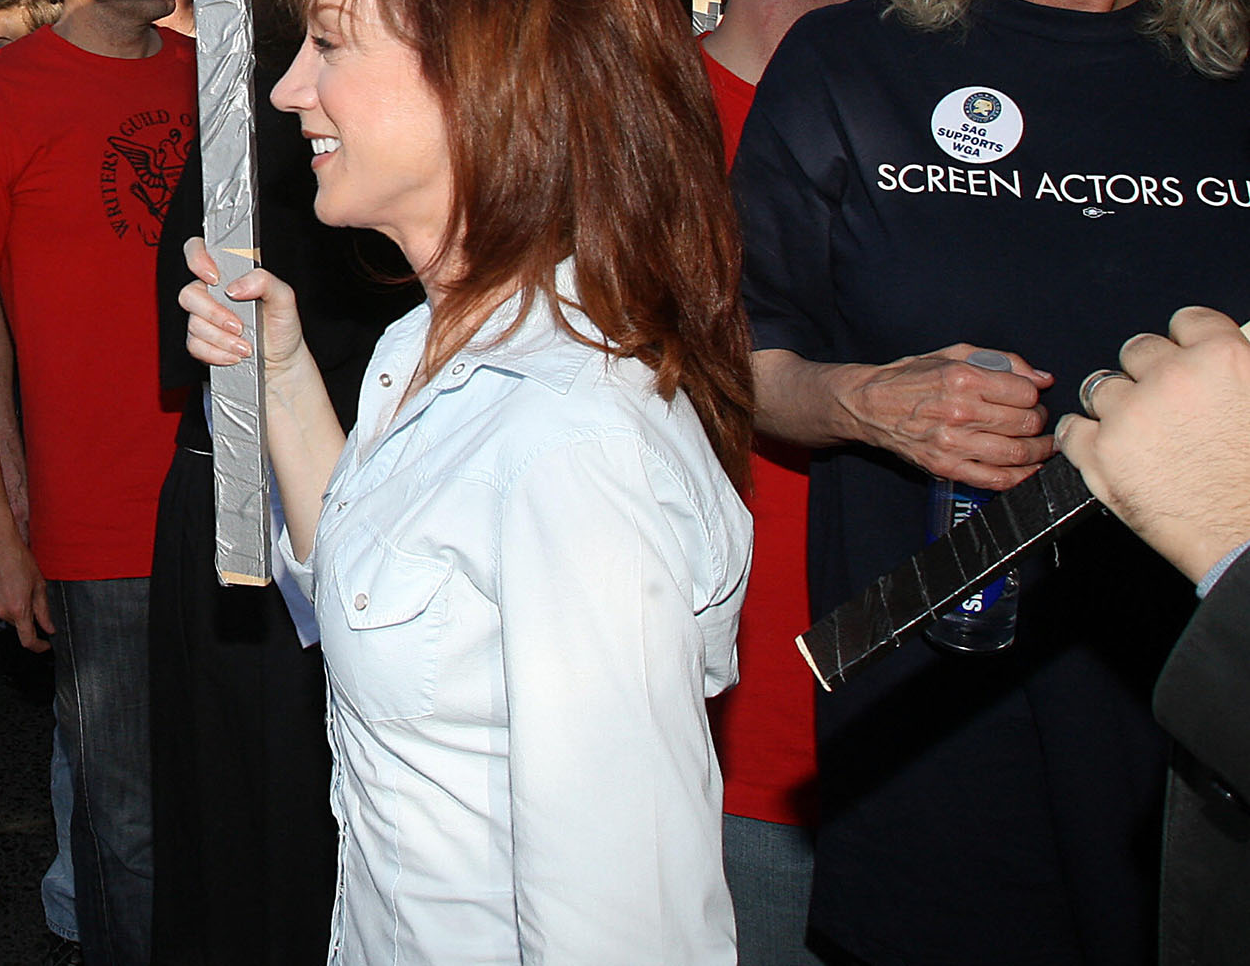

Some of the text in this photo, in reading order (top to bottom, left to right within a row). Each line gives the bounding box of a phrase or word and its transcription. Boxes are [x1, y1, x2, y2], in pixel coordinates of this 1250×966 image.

[937, 127, 1004, 153] SUPPORTS
[960, 123, 987, 137] SAG
[952, 142, 981, 157] WGA
[101, 149, 130, 239] WRITERS
[119, 109, 171, 137] GUILD
[876, 163, 1022, 199] SCREEN
[1035, 171, 1184, 208] ACTORS
